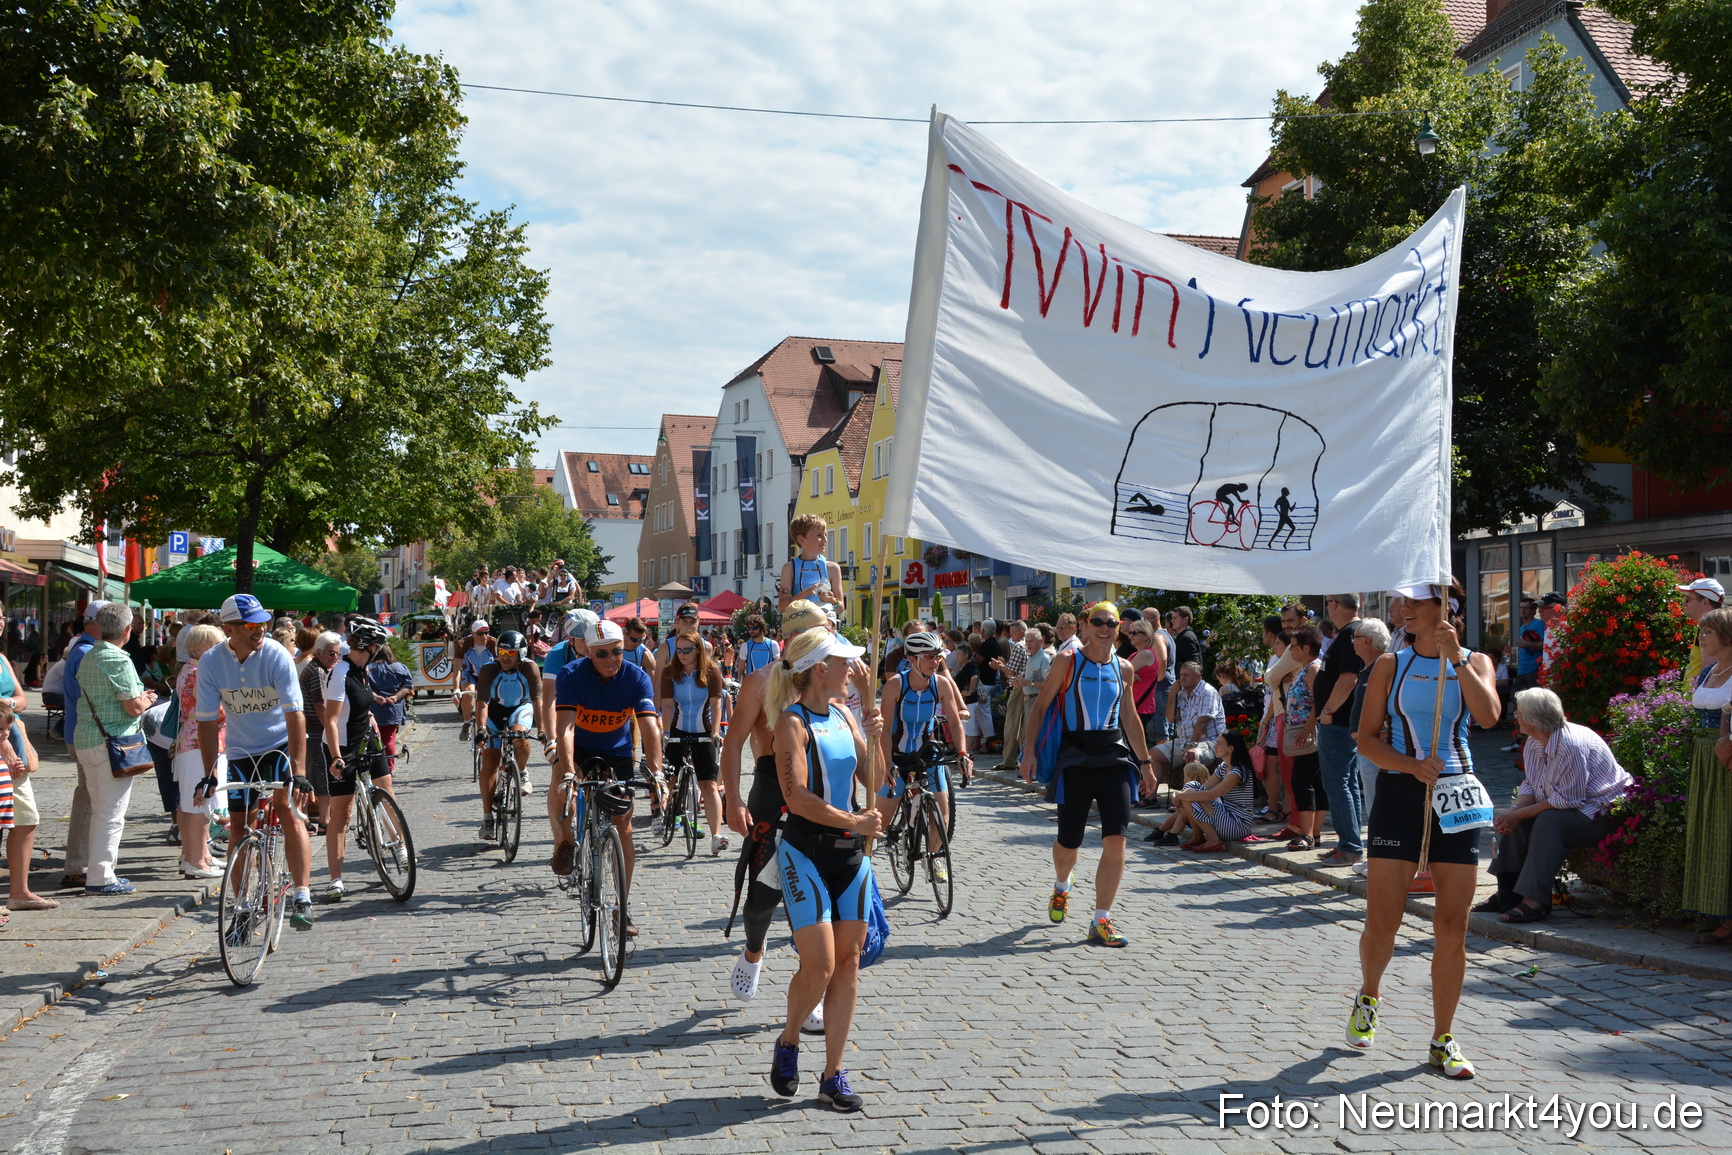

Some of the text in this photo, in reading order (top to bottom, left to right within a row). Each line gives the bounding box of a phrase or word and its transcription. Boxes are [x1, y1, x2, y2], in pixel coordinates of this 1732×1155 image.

[173, 534, 184, 551] P
[432, 658, 449, 677] TSV
[228, 688, 266, 700] TWIN
[577, 709, 628, 726] EXPRESS
[1437, 786, 1484, 813] 2197
[1453, 812, 1482, 824] Andrea
